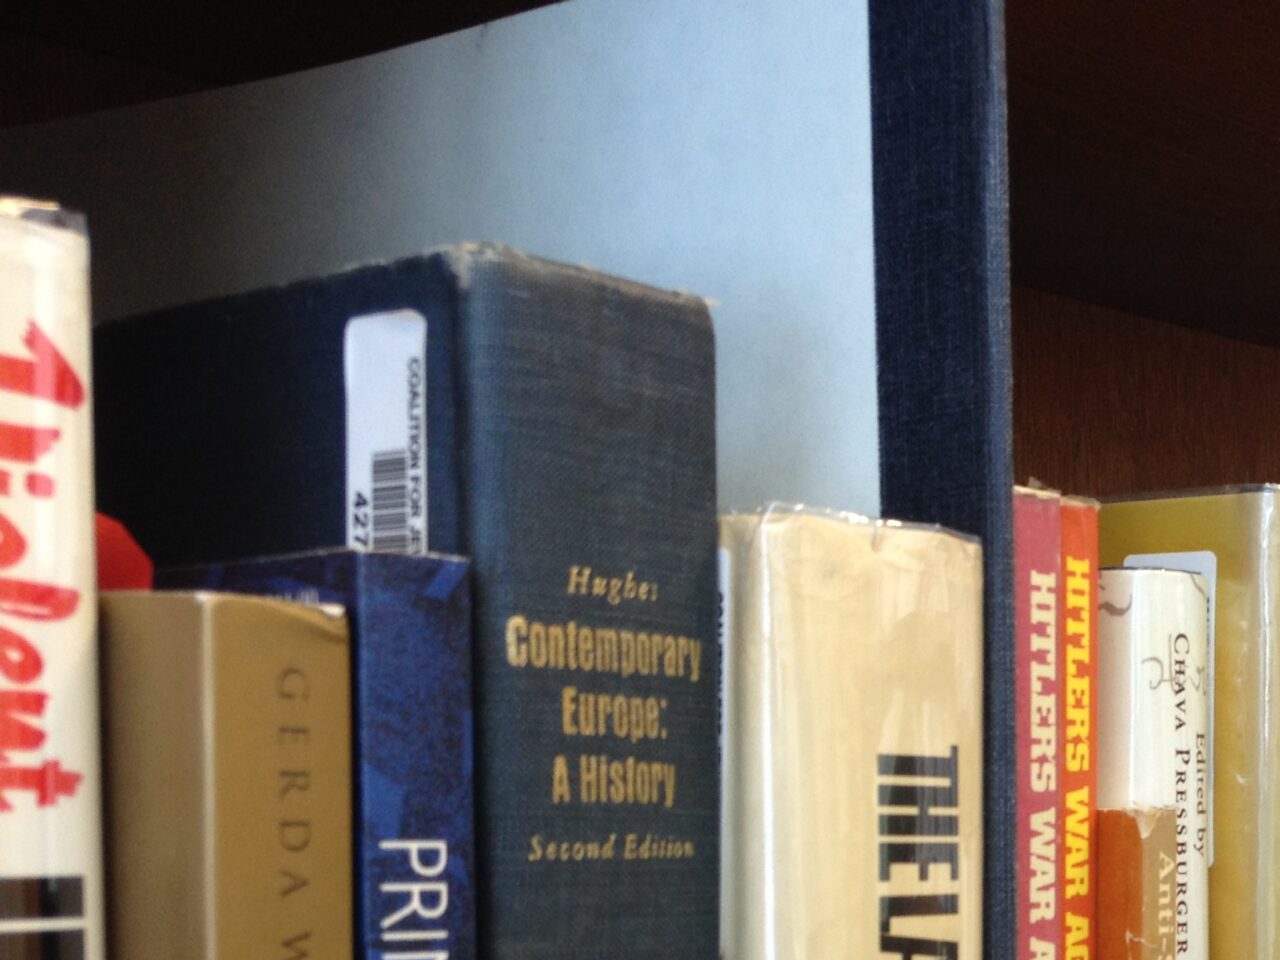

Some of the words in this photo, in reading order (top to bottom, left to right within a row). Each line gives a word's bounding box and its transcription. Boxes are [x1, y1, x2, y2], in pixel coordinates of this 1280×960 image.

[409, 475, 421, 517] FOR
[566, 564, 659, 605] Hughes
[505, 614, 702, 682] Contemporary
[1029, 570, 1056, 793] HITLER'S
[1065, 556, 1089, 772] HITLER'S
[1173, 632, 1191, 732] CHAVA
[560, 685, 667, 743] Europe:
[276, 668, 312, 898] GERDA
[551, 754, 572, 804] A
[579, 754, 677, 808] History
[877, 745, 959, 883] THE
[1195, 731, 1206, 817] Edited
[527, 832, 618, 862] Second
[623, 833, 695, 860] Edition
[1029, 807, 1055, 924] WAR
[1065, 786, 1089, 900] WAR
[1174, 748, 1192, 957] PRESSBURGER
[1193, 827, 1206, 858] by
